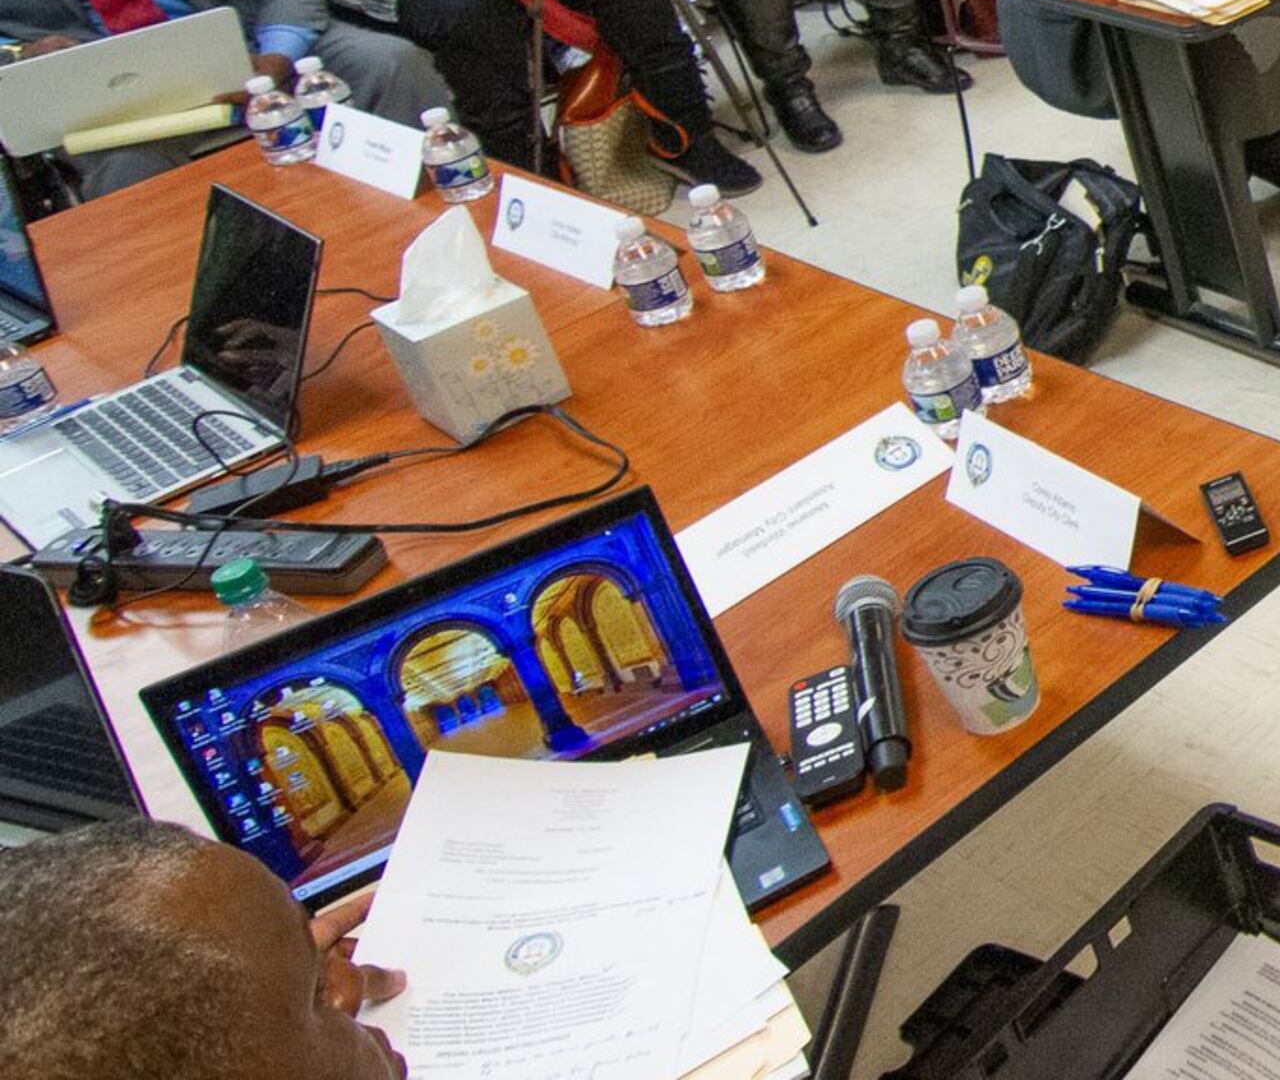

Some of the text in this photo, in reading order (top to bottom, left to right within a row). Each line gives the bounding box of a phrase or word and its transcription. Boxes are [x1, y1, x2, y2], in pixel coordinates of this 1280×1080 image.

[716, 482, 836, 558] Assistant City Manager
